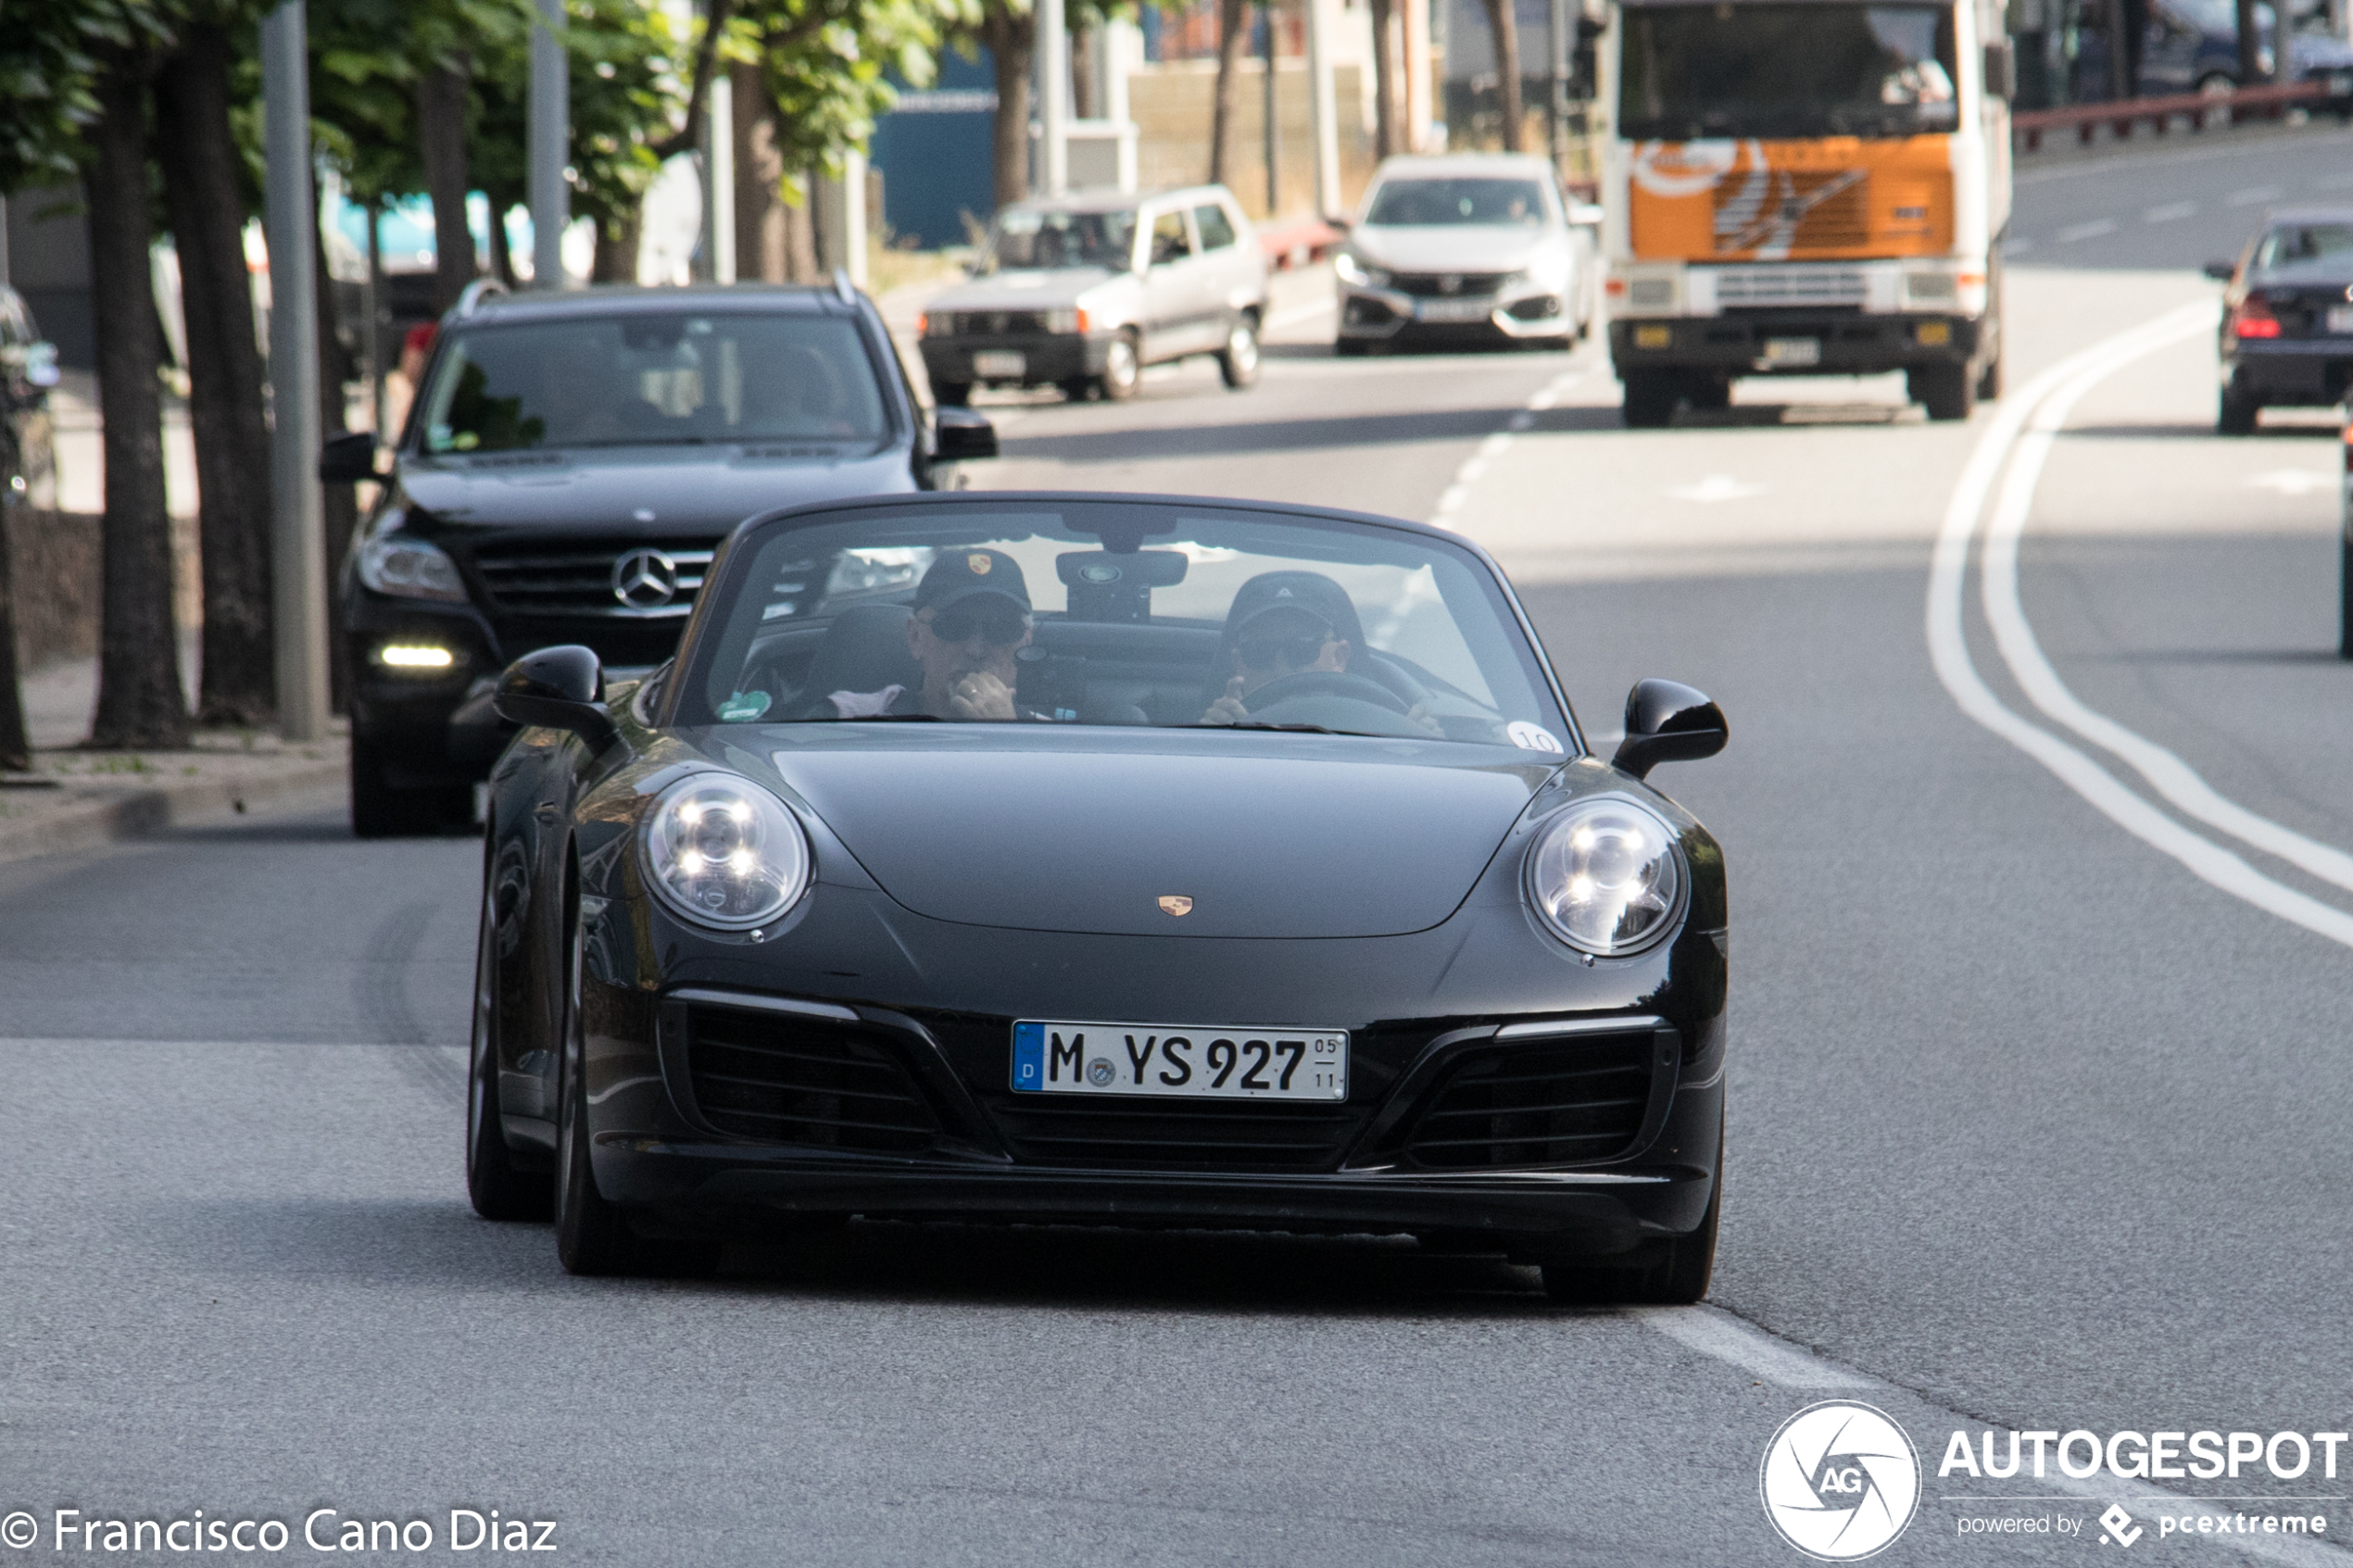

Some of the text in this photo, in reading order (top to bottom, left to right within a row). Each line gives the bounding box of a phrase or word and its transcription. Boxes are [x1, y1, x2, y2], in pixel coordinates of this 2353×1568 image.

[1517, 731, 1555, 752] 10
[1315, 1038, 1337, 1054] 05
[1023, 1032, 1306, 1090] D M YS 927
[1315, 1073, 1335, 1088] 11
